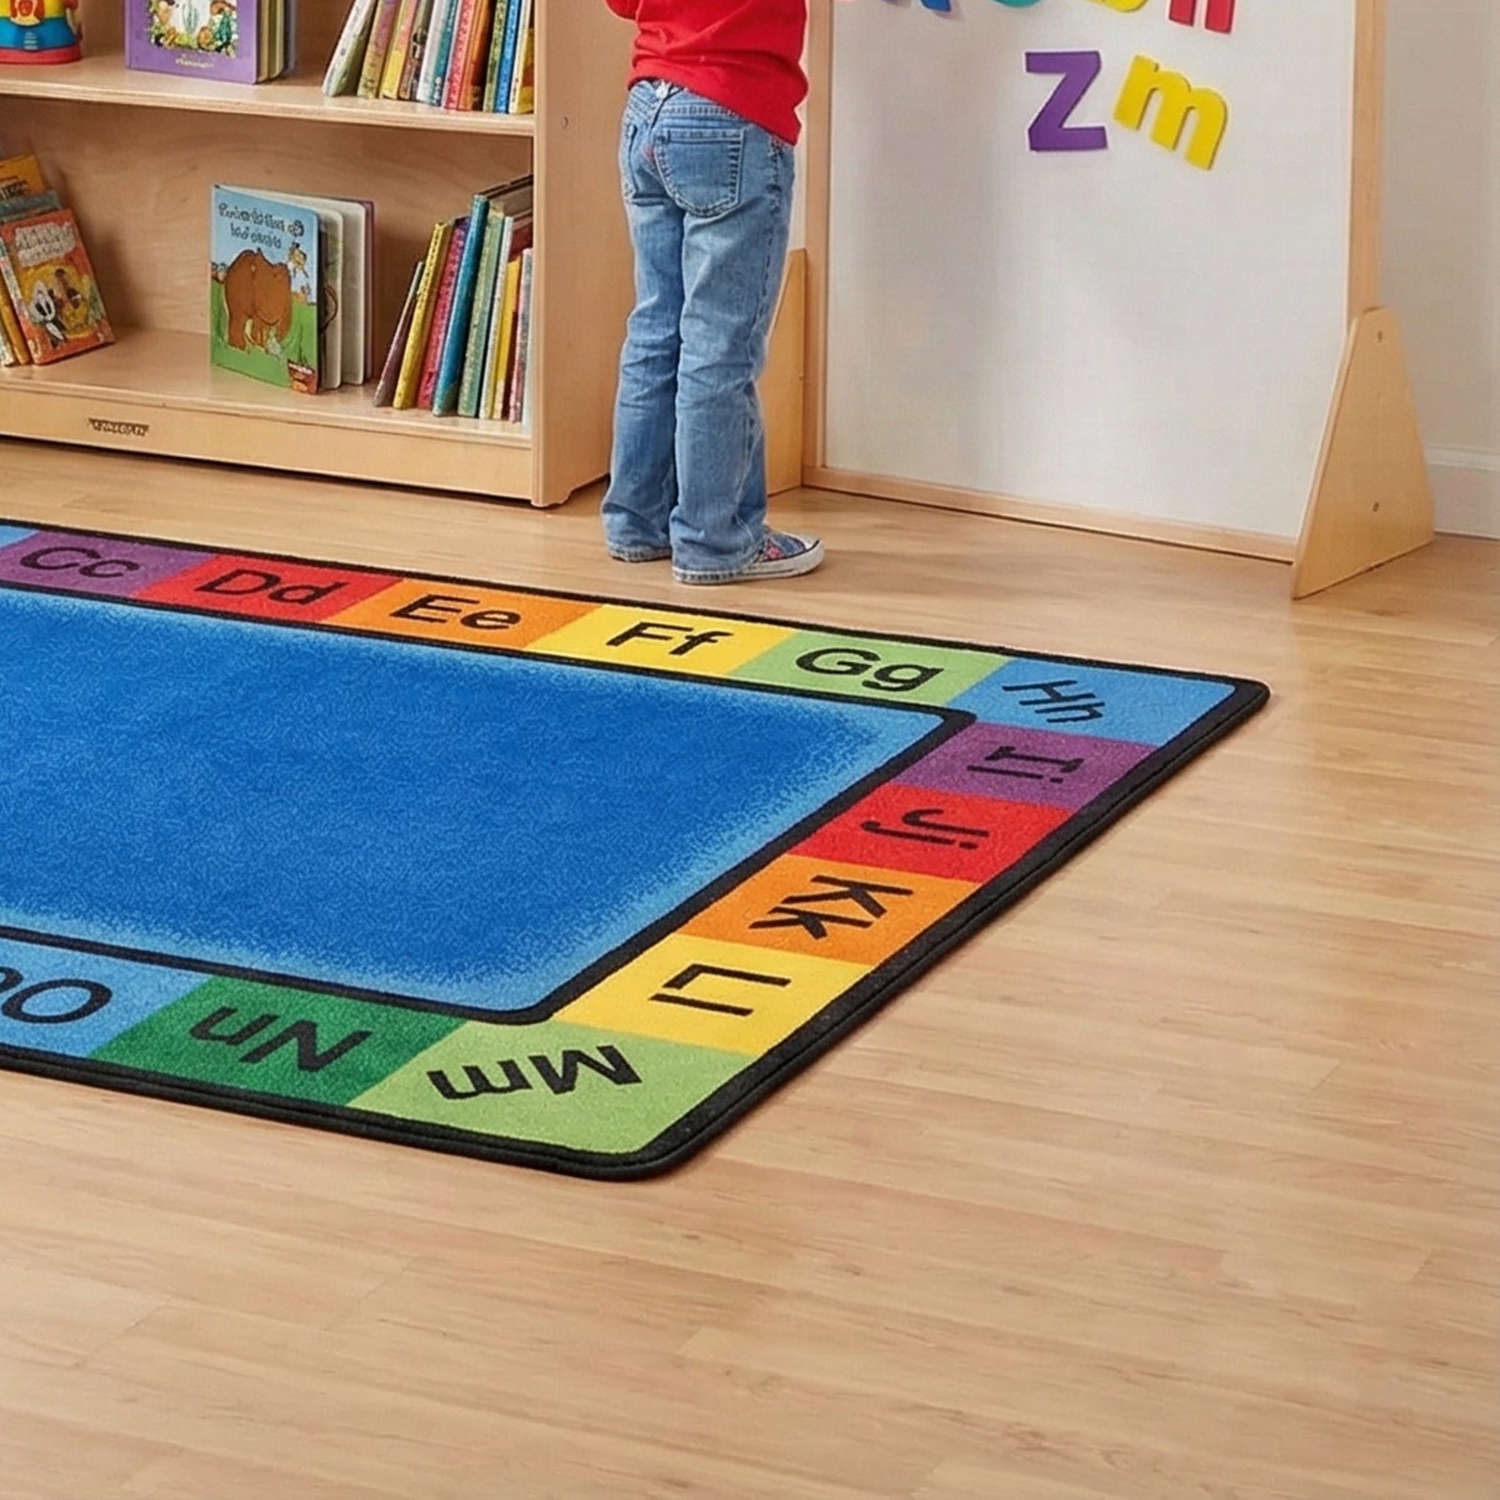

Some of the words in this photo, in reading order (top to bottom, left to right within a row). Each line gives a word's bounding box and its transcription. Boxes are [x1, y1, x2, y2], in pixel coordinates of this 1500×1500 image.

[1114, 55, 1228, 170] m
[18, 546, 140, 579] Cc
[193, 569, 351, 607] Dd
[390, 595, 522, 632] Ee
[605, 621, 734, 656] Ff
[795, 648, 945, 689] Gg
[1002, 679, 1104, 724] Hh
[861, 809, 989, 850] Jj
[749, 874, 912, 939] Kk
[190, 1006, 373, 1072] Nn
[428, 1045, 643, 1100] Mm
